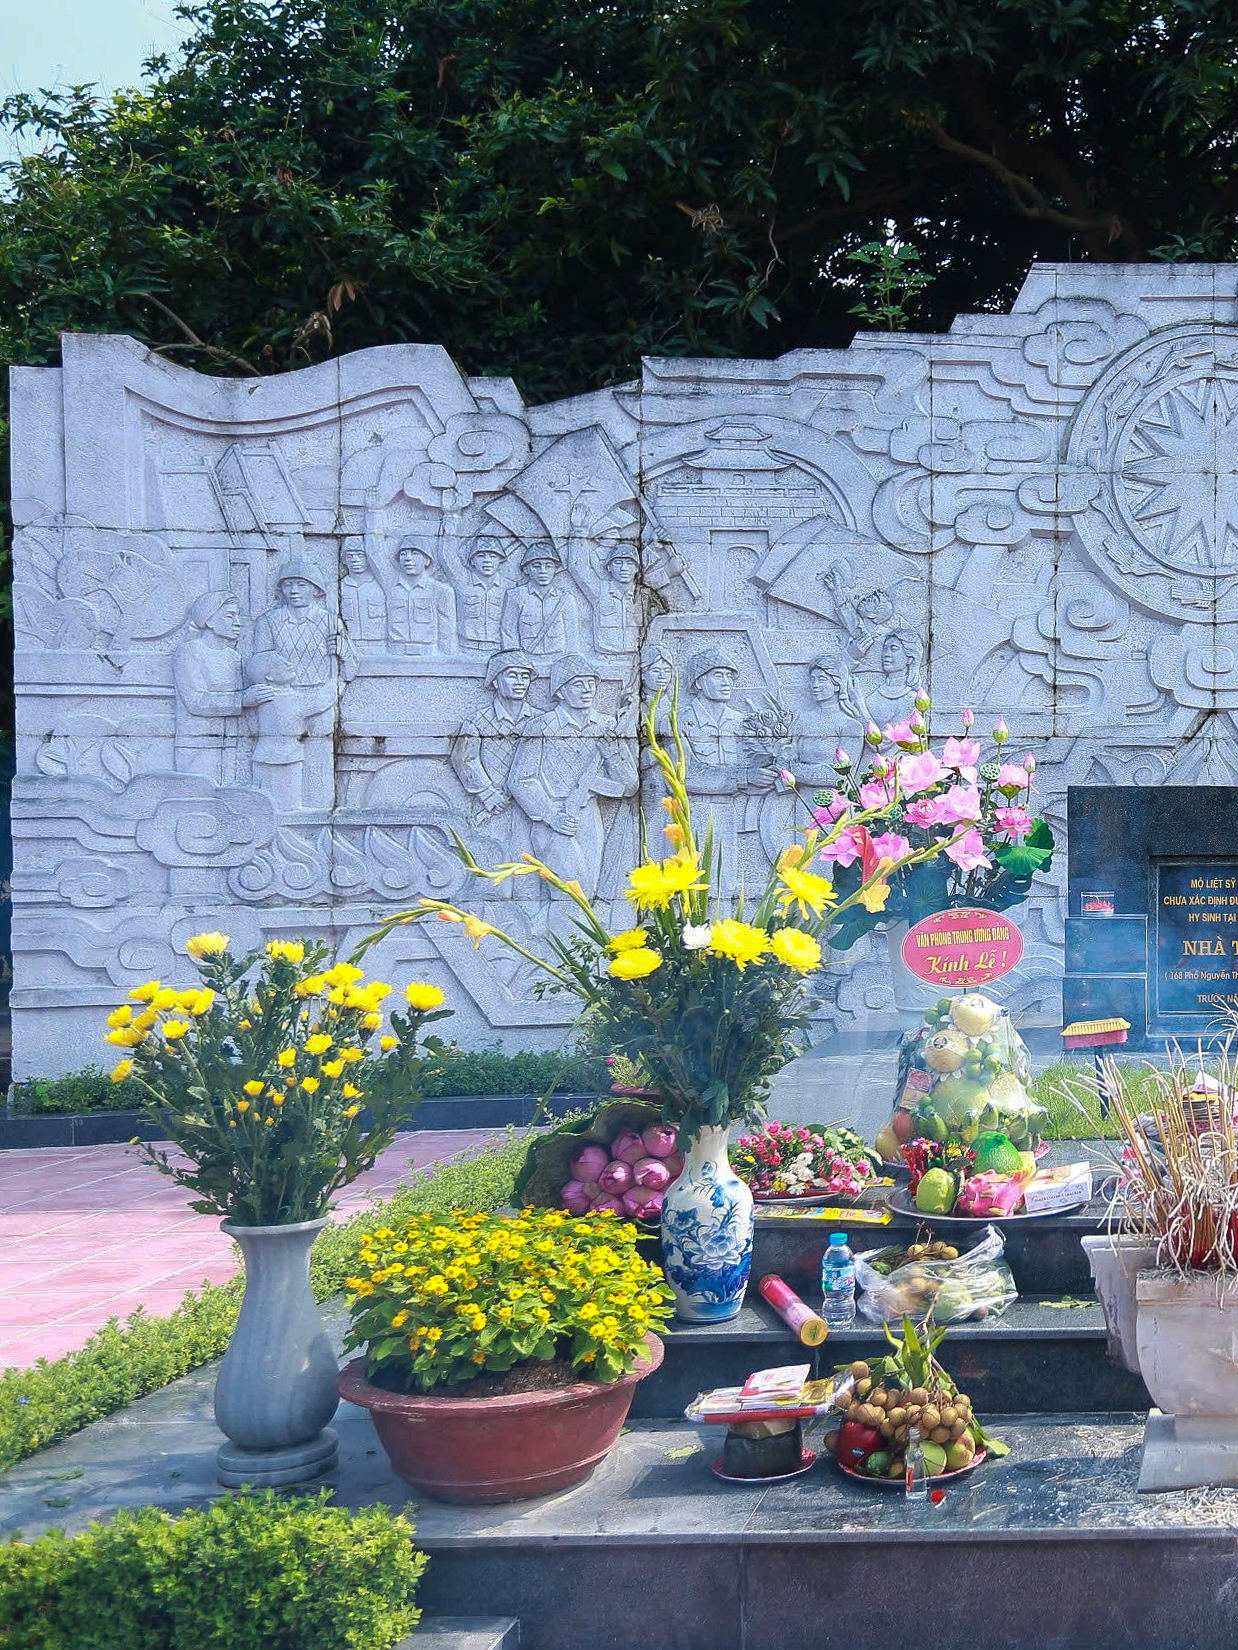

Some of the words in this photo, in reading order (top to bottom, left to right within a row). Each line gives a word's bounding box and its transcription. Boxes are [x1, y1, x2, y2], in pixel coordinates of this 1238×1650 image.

[1190, 876, 1204, 890] MỘ
[1206, 877, 1223, 890] LIỆT
[1163, 895, 1187, 906] CHƯA
[1189, 893, 1206, 905] XÁC
[1208, 896, 1228, 907] ĐỊNH
[1189, 913, 1200, 922] HY
[1202, 913, 1221, 922] SINH
[1223, 913, 1236, 924] TẠI
[916, 932, 930, 947] VĂN
[930, 929, 952, 946] PHÒNG
[952, 929, 973, 944] TRUNG
[974, 927, 992, 942] ƯƠNG
[1182, 935, 1227, 956] NHÀ
[924, 954, 971, 975] Kính
[974, 949, 998, 970] Lễ
[1170, 971, 1183, 980] 168
[1200, 970, 1230, 981] Nguyễn
